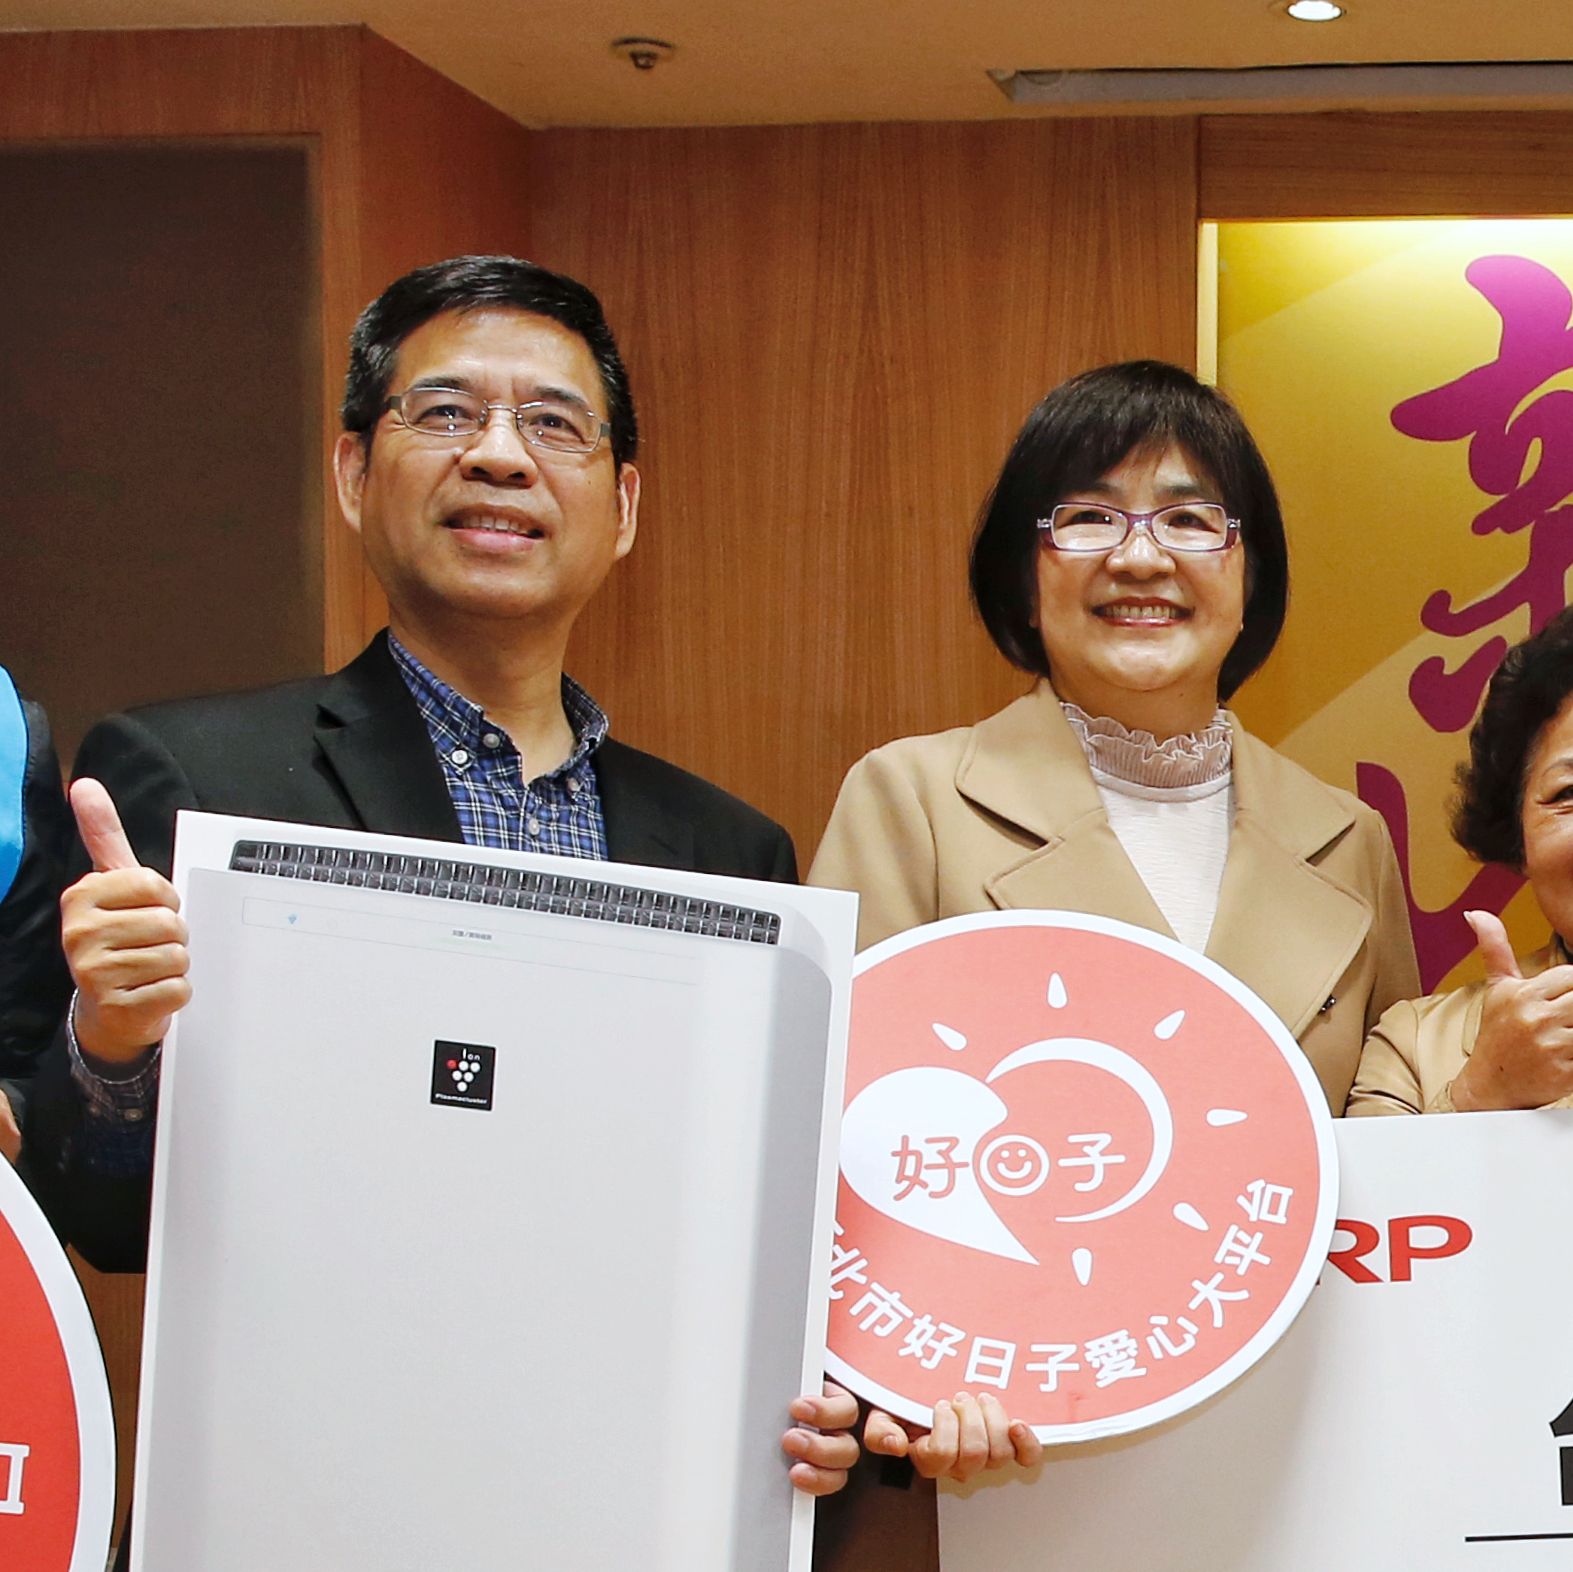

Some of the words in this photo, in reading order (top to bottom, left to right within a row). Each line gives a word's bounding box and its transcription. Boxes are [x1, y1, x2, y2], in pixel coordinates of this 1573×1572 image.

[828, 1178, 1294, 1392] 北市好日子愛心大平台
